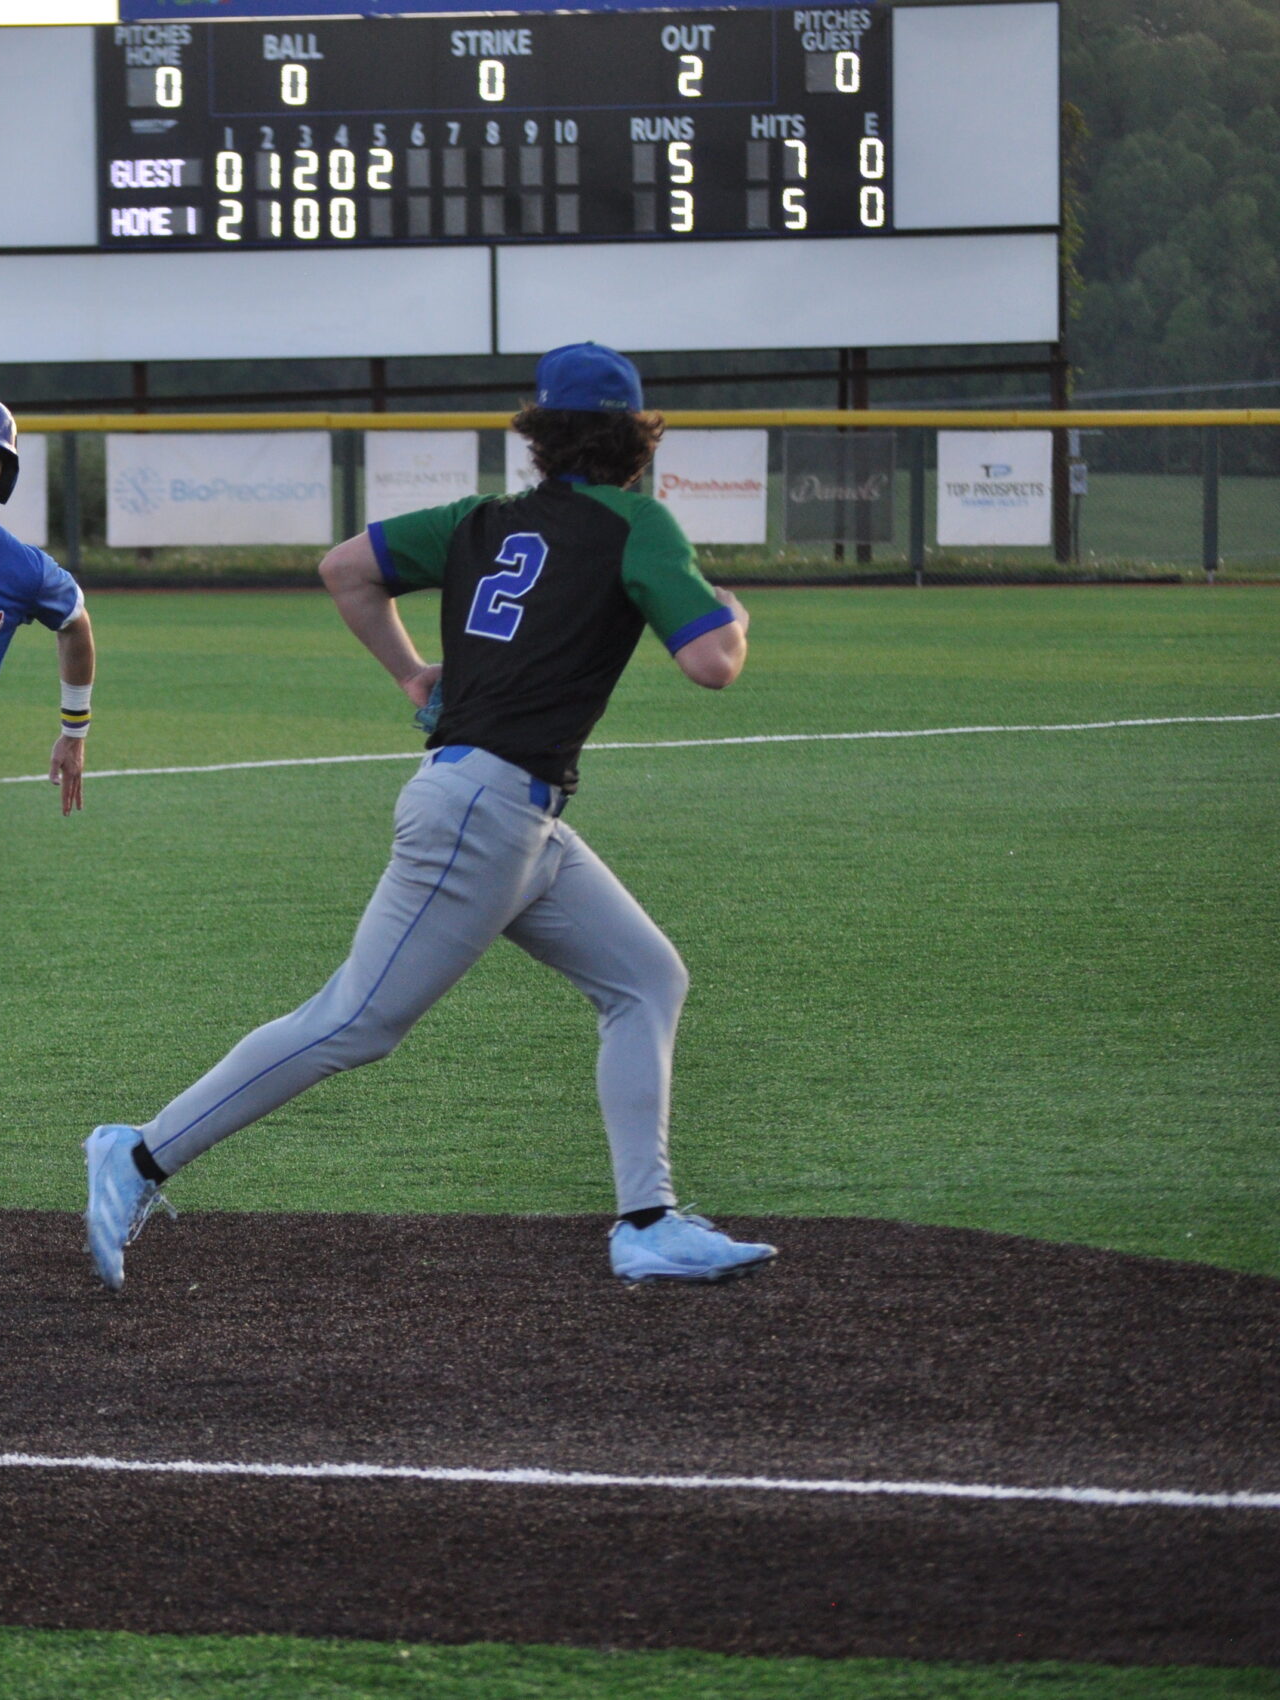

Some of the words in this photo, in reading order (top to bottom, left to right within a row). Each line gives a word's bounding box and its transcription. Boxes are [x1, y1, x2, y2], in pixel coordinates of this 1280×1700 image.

[793, 9, 871, 31] PITCHES
[114, 24, 192, 45] PITCHES
[263, 34, 324, 60] BALL
[451, 29, 533, 56] STRIKE
[661, 25, 715, 52] OUT
[801, 30, 863, 51] GUEST
[126, 45, 181, 66] HOME
[281, 64, 308, 105] 0
[479, 60, 505, 101] 0
[678, 55, 703, 97] 2
[835, 51, 860, 93] 0
[156, 66, 182, 108] 0
[225, 127, 234, 149] 1
[260, 126, 274, 149] 2
[298, 125, 313, 148] 3
[334, 124, 349, 147] 4
[373, 123, 388, 147] 5
[411, 122, 426, 146] 6
[447, 121, 461, 145] 7
[486, 120, 501, 145] 8
[524, 118, 538, 143] 9
[554, 119, 578, 143] 10
[630, 117, 694, 141] RUNS
[751, 114, 806, 138] HITS
[865, 112, 879, 136] E
[110, 158, 186, 188] GUEST
[216, 151, 243, 193] 0
[668, 142, 693, 184] 5
[783, 140, 807, 179] 7
[859, 138, 884, 179] 0
[110, 206, 173, 237] HOME
[216, 199, 243, 241] 2
[670, 190, 694, 233] 3
[782, 188, 807, 230] 5
[859, 186, 884, 228] 0
[170, 477, 327, 502] BioPrecision
[946, 481, 970, 498] TOP
[973, 480, 1046, 498] PROSPECTS
[465, 533, 549, 642] 2
